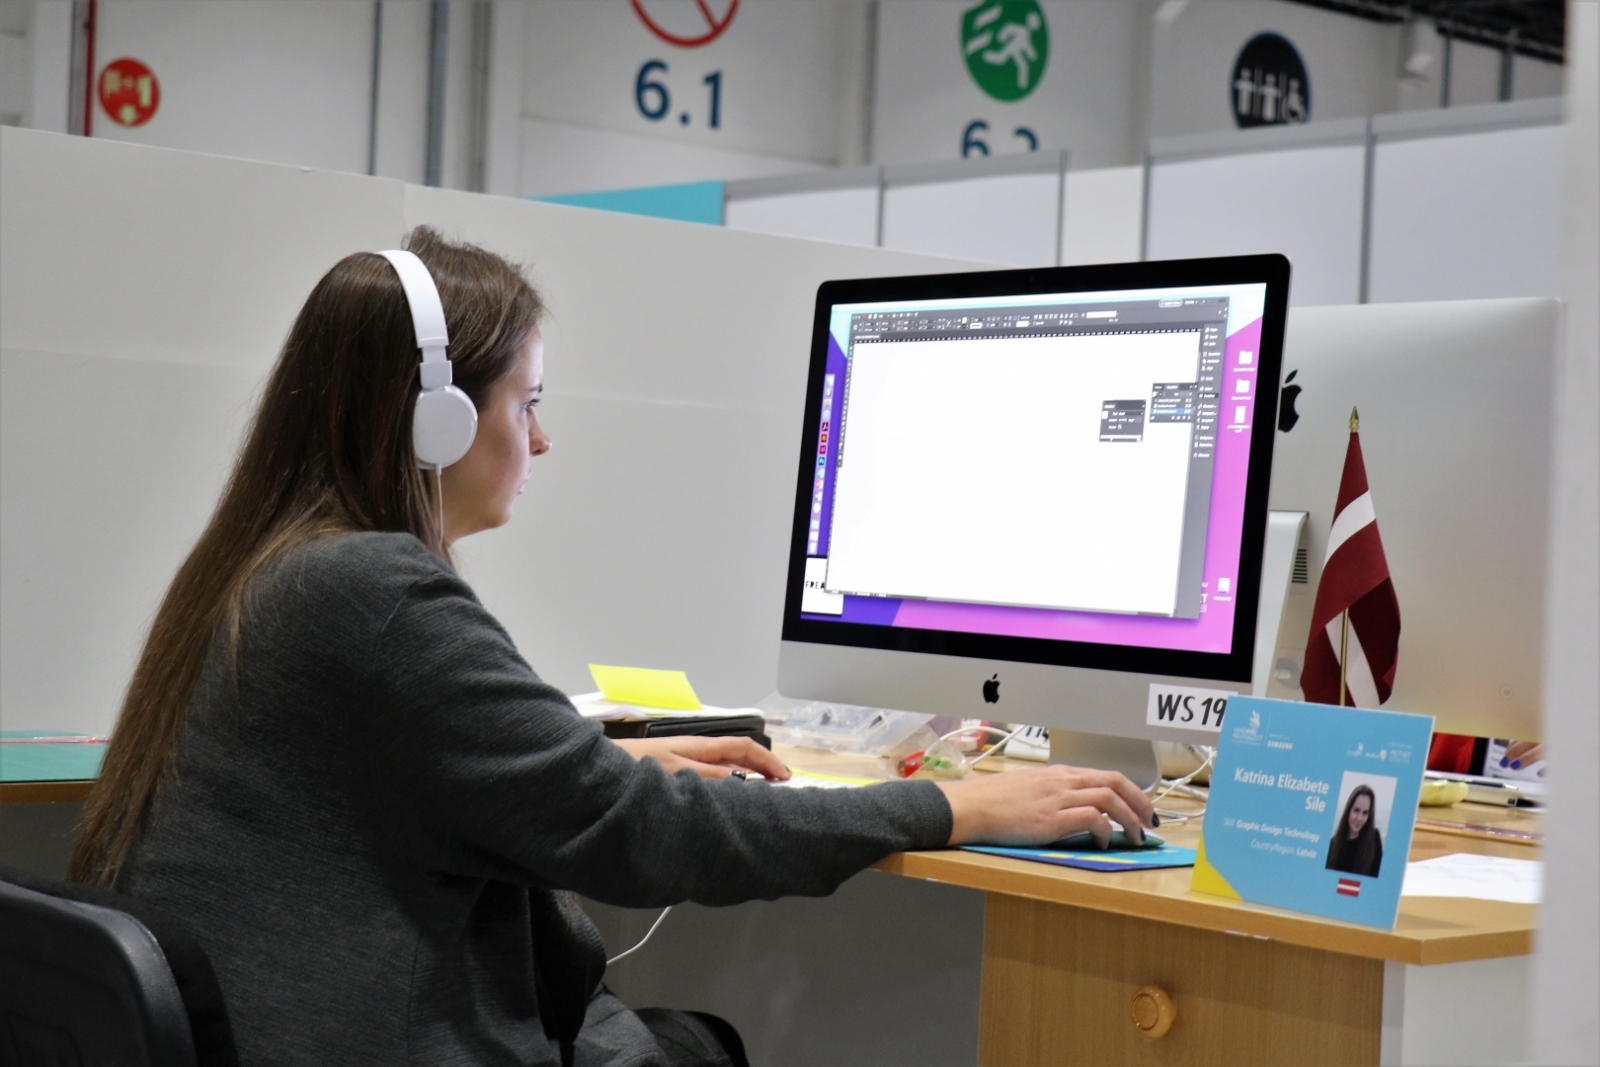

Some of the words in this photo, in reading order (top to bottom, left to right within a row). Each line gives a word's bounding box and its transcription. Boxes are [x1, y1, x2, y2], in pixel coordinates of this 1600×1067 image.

[634, 59, 722, 129] 6.1
[1157, 693, 1196, 722] WS
[1200, 697, 1228, 727] 19
[1267, 740, 1294, 751] SAMSUNG
[1234, 767, 1275, 787] Katrina
[1277, 773, 1330, 795] Elizabete
[1304, 795, 1326, 813] Sile
[1236, 819, 1260, 831] Graphic
[1261, 823, 1283, 836] Design
[1284, 827, 1320, 843] Technology
[1296, 847, 1317, 859] Latvia
